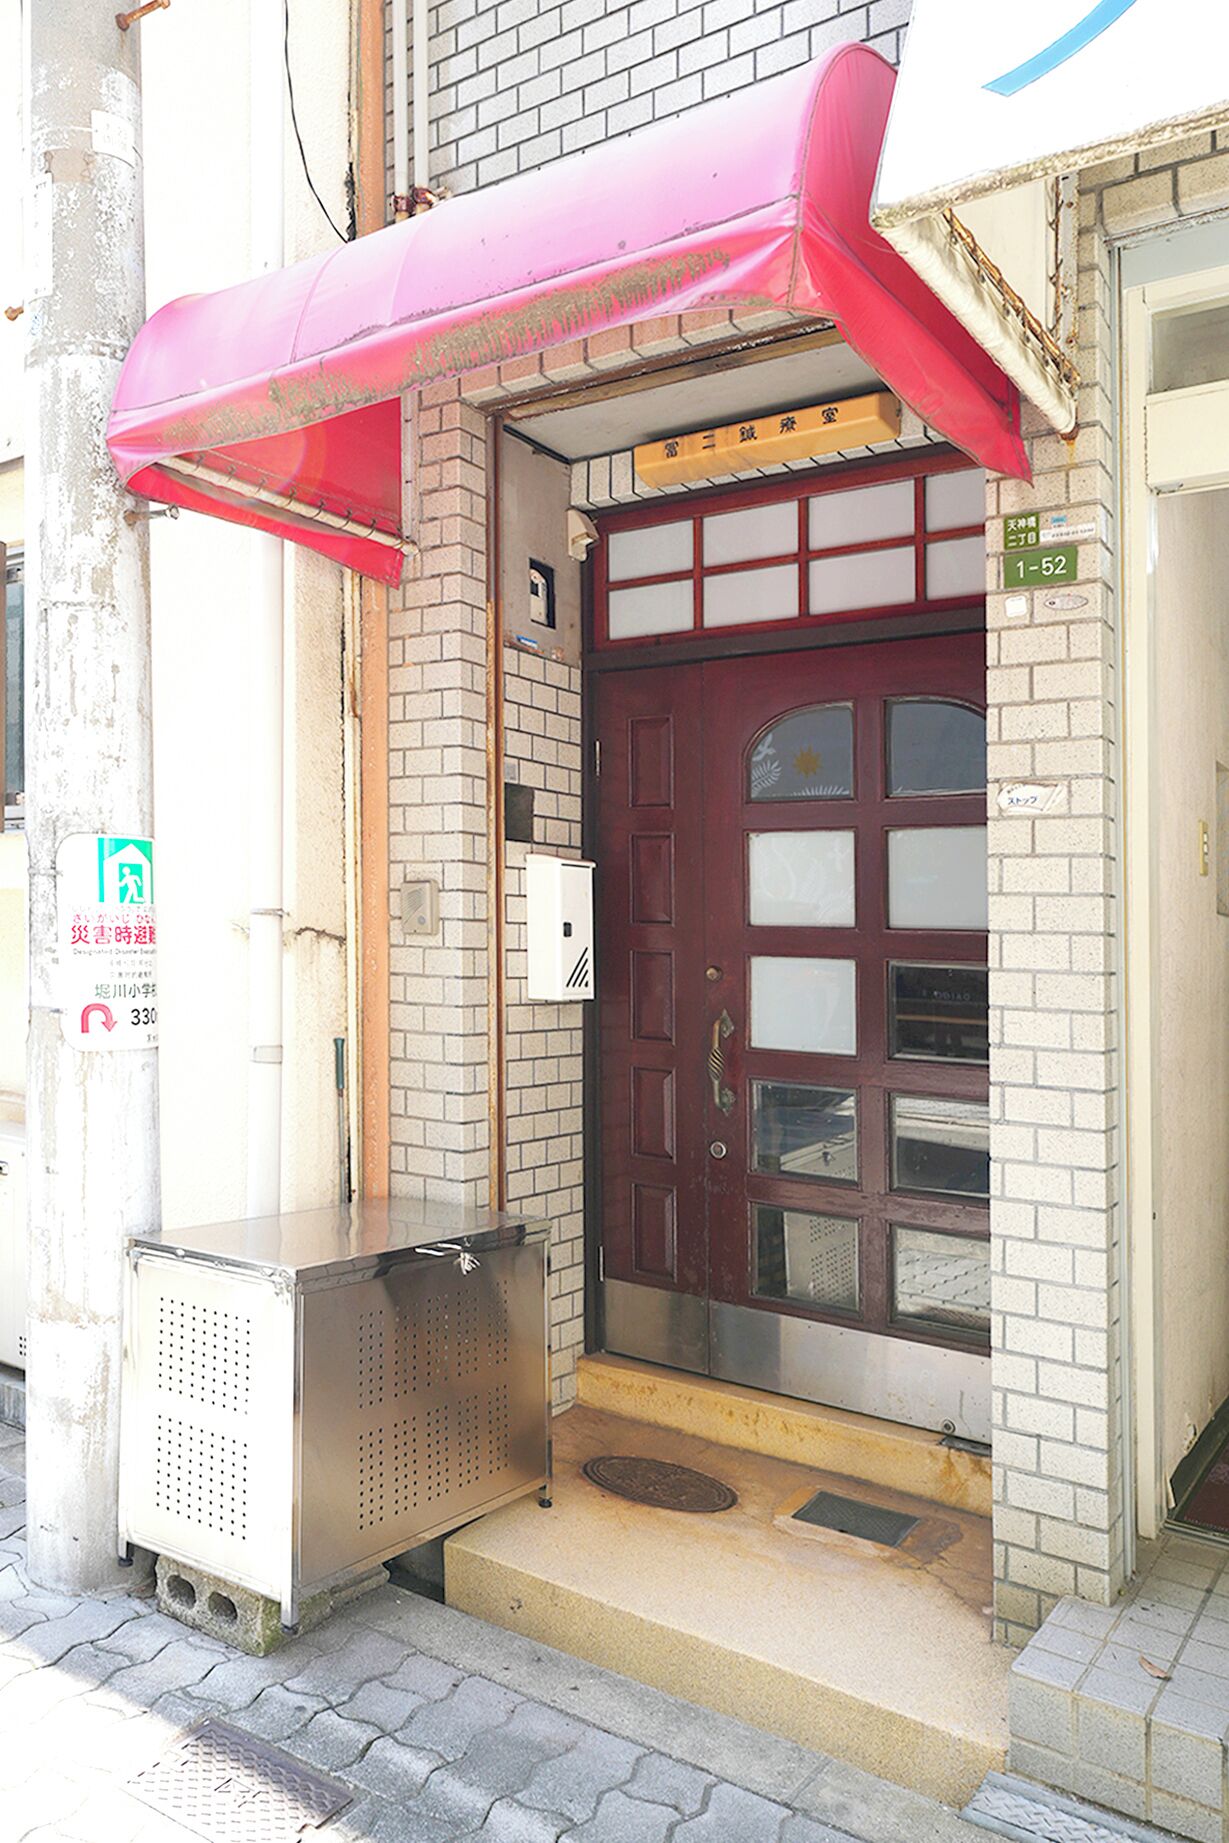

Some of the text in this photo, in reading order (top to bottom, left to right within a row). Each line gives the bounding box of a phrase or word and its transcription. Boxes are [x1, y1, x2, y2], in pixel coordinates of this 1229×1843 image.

[1007, 516, 1037, 531] 天神橋
[1007, 532, 1037, 547] 二丁目
[1016, 555, 1067, 579] 1-52
